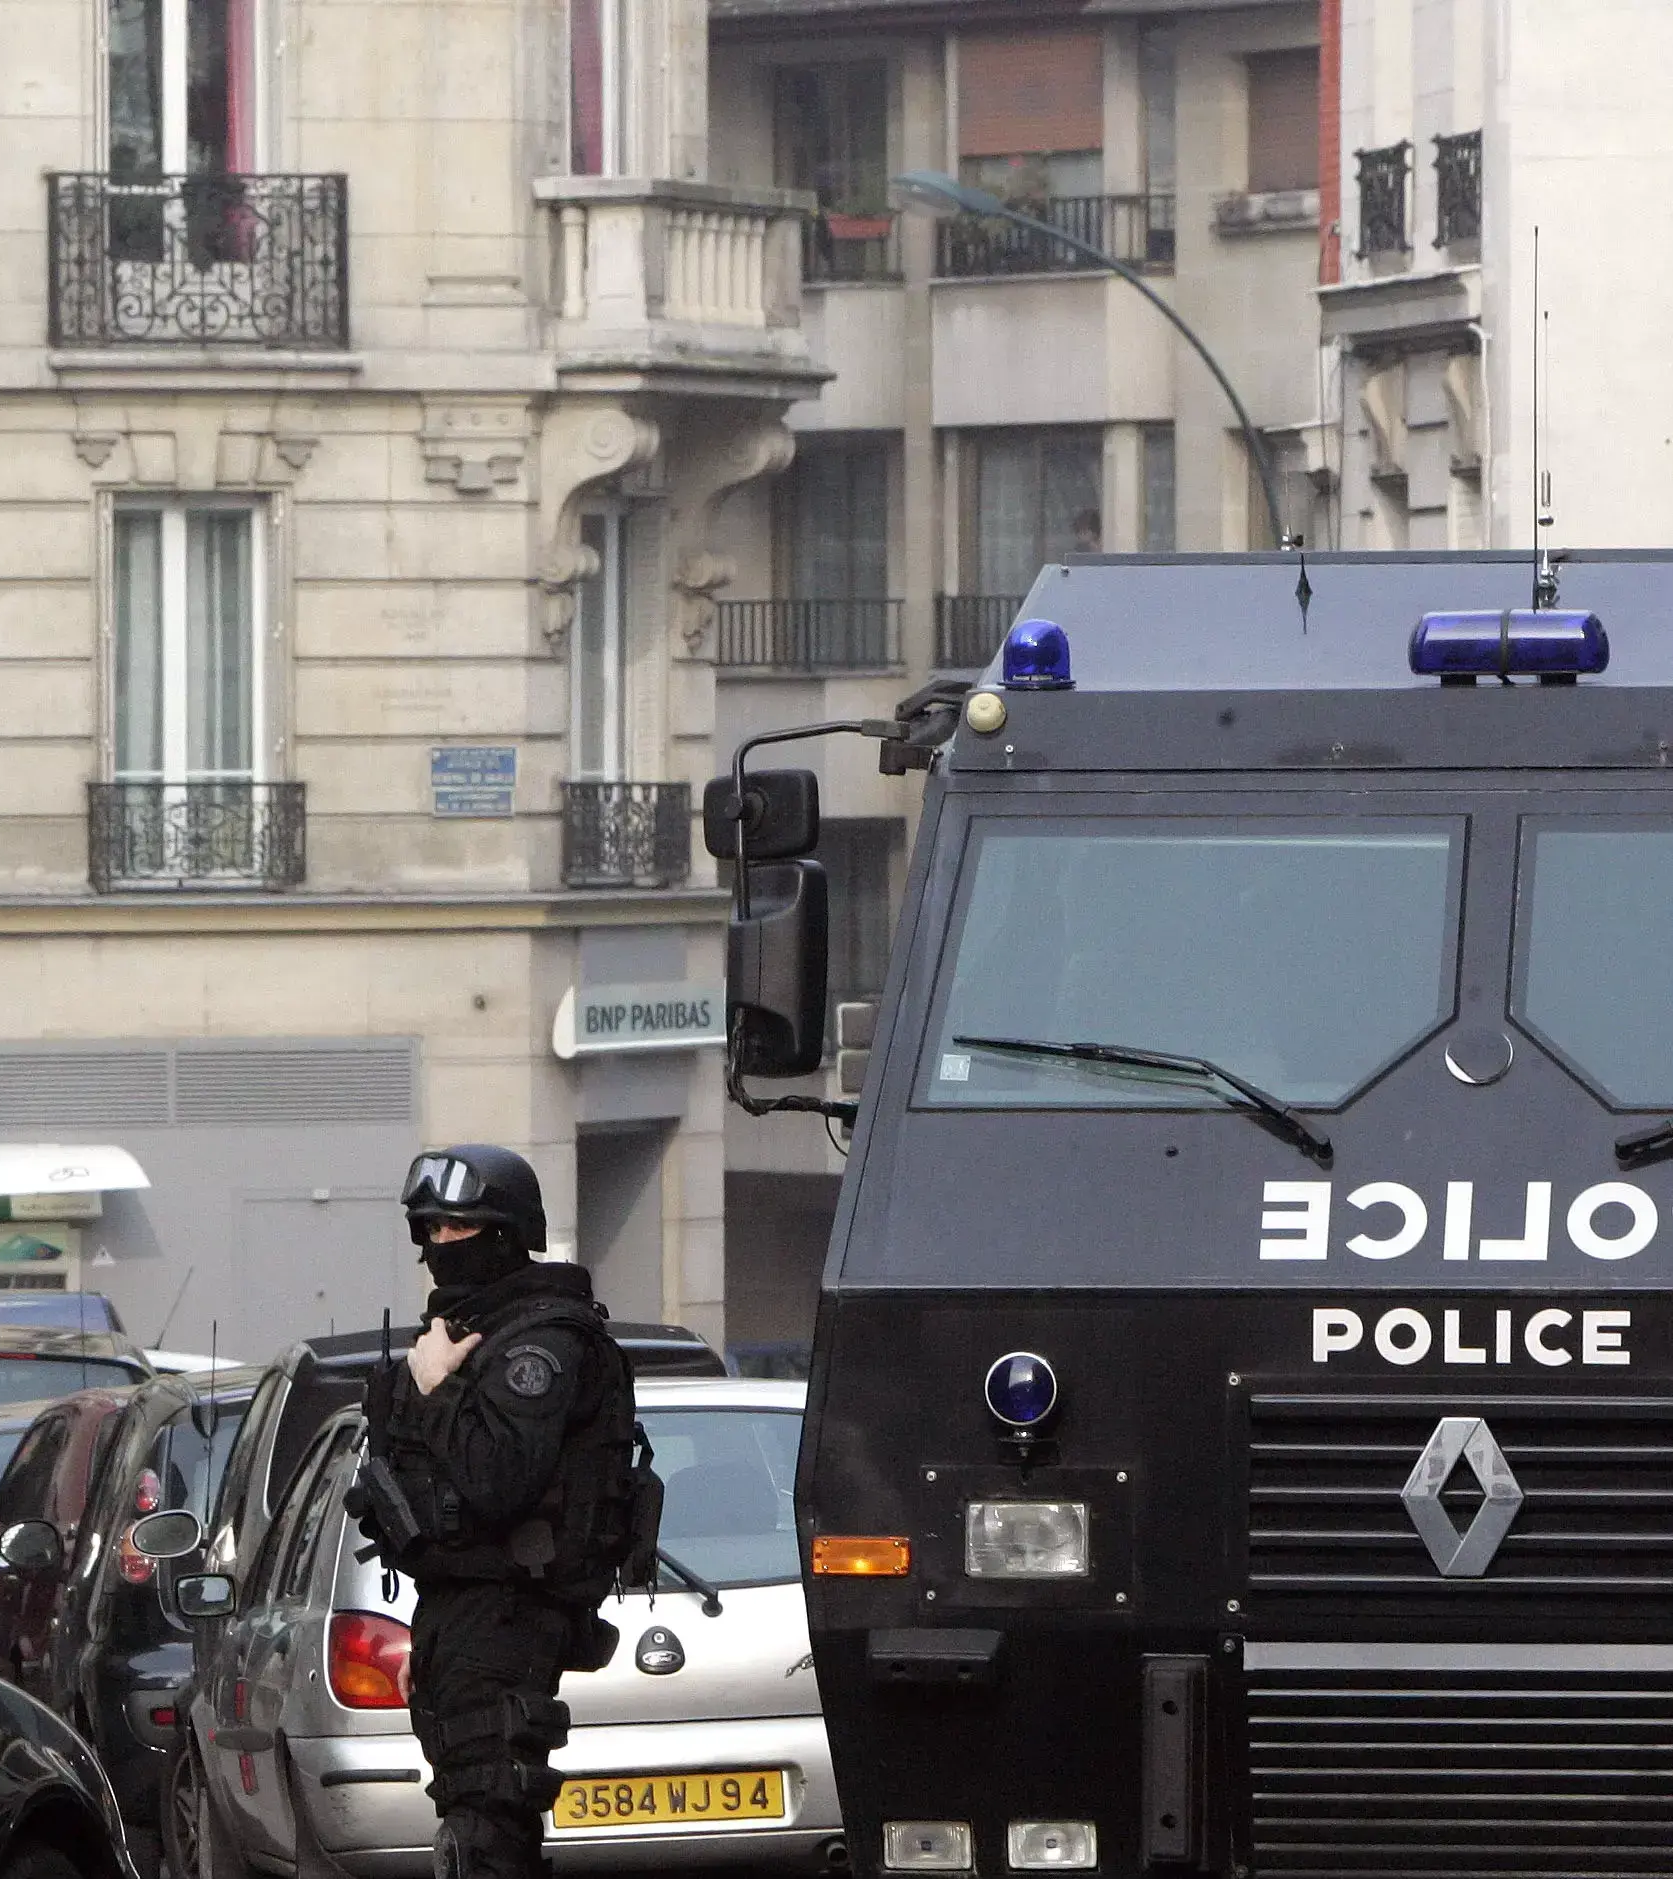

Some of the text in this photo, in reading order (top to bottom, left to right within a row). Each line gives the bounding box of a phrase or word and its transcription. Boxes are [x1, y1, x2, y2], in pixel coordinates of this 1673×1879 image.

[586, 1000, 710, 1033] BNP PARIBAS
[1313, 1308, 1631, 1366] POLICE
[568, 1778, 769, 1819] 3584 WJ 94
